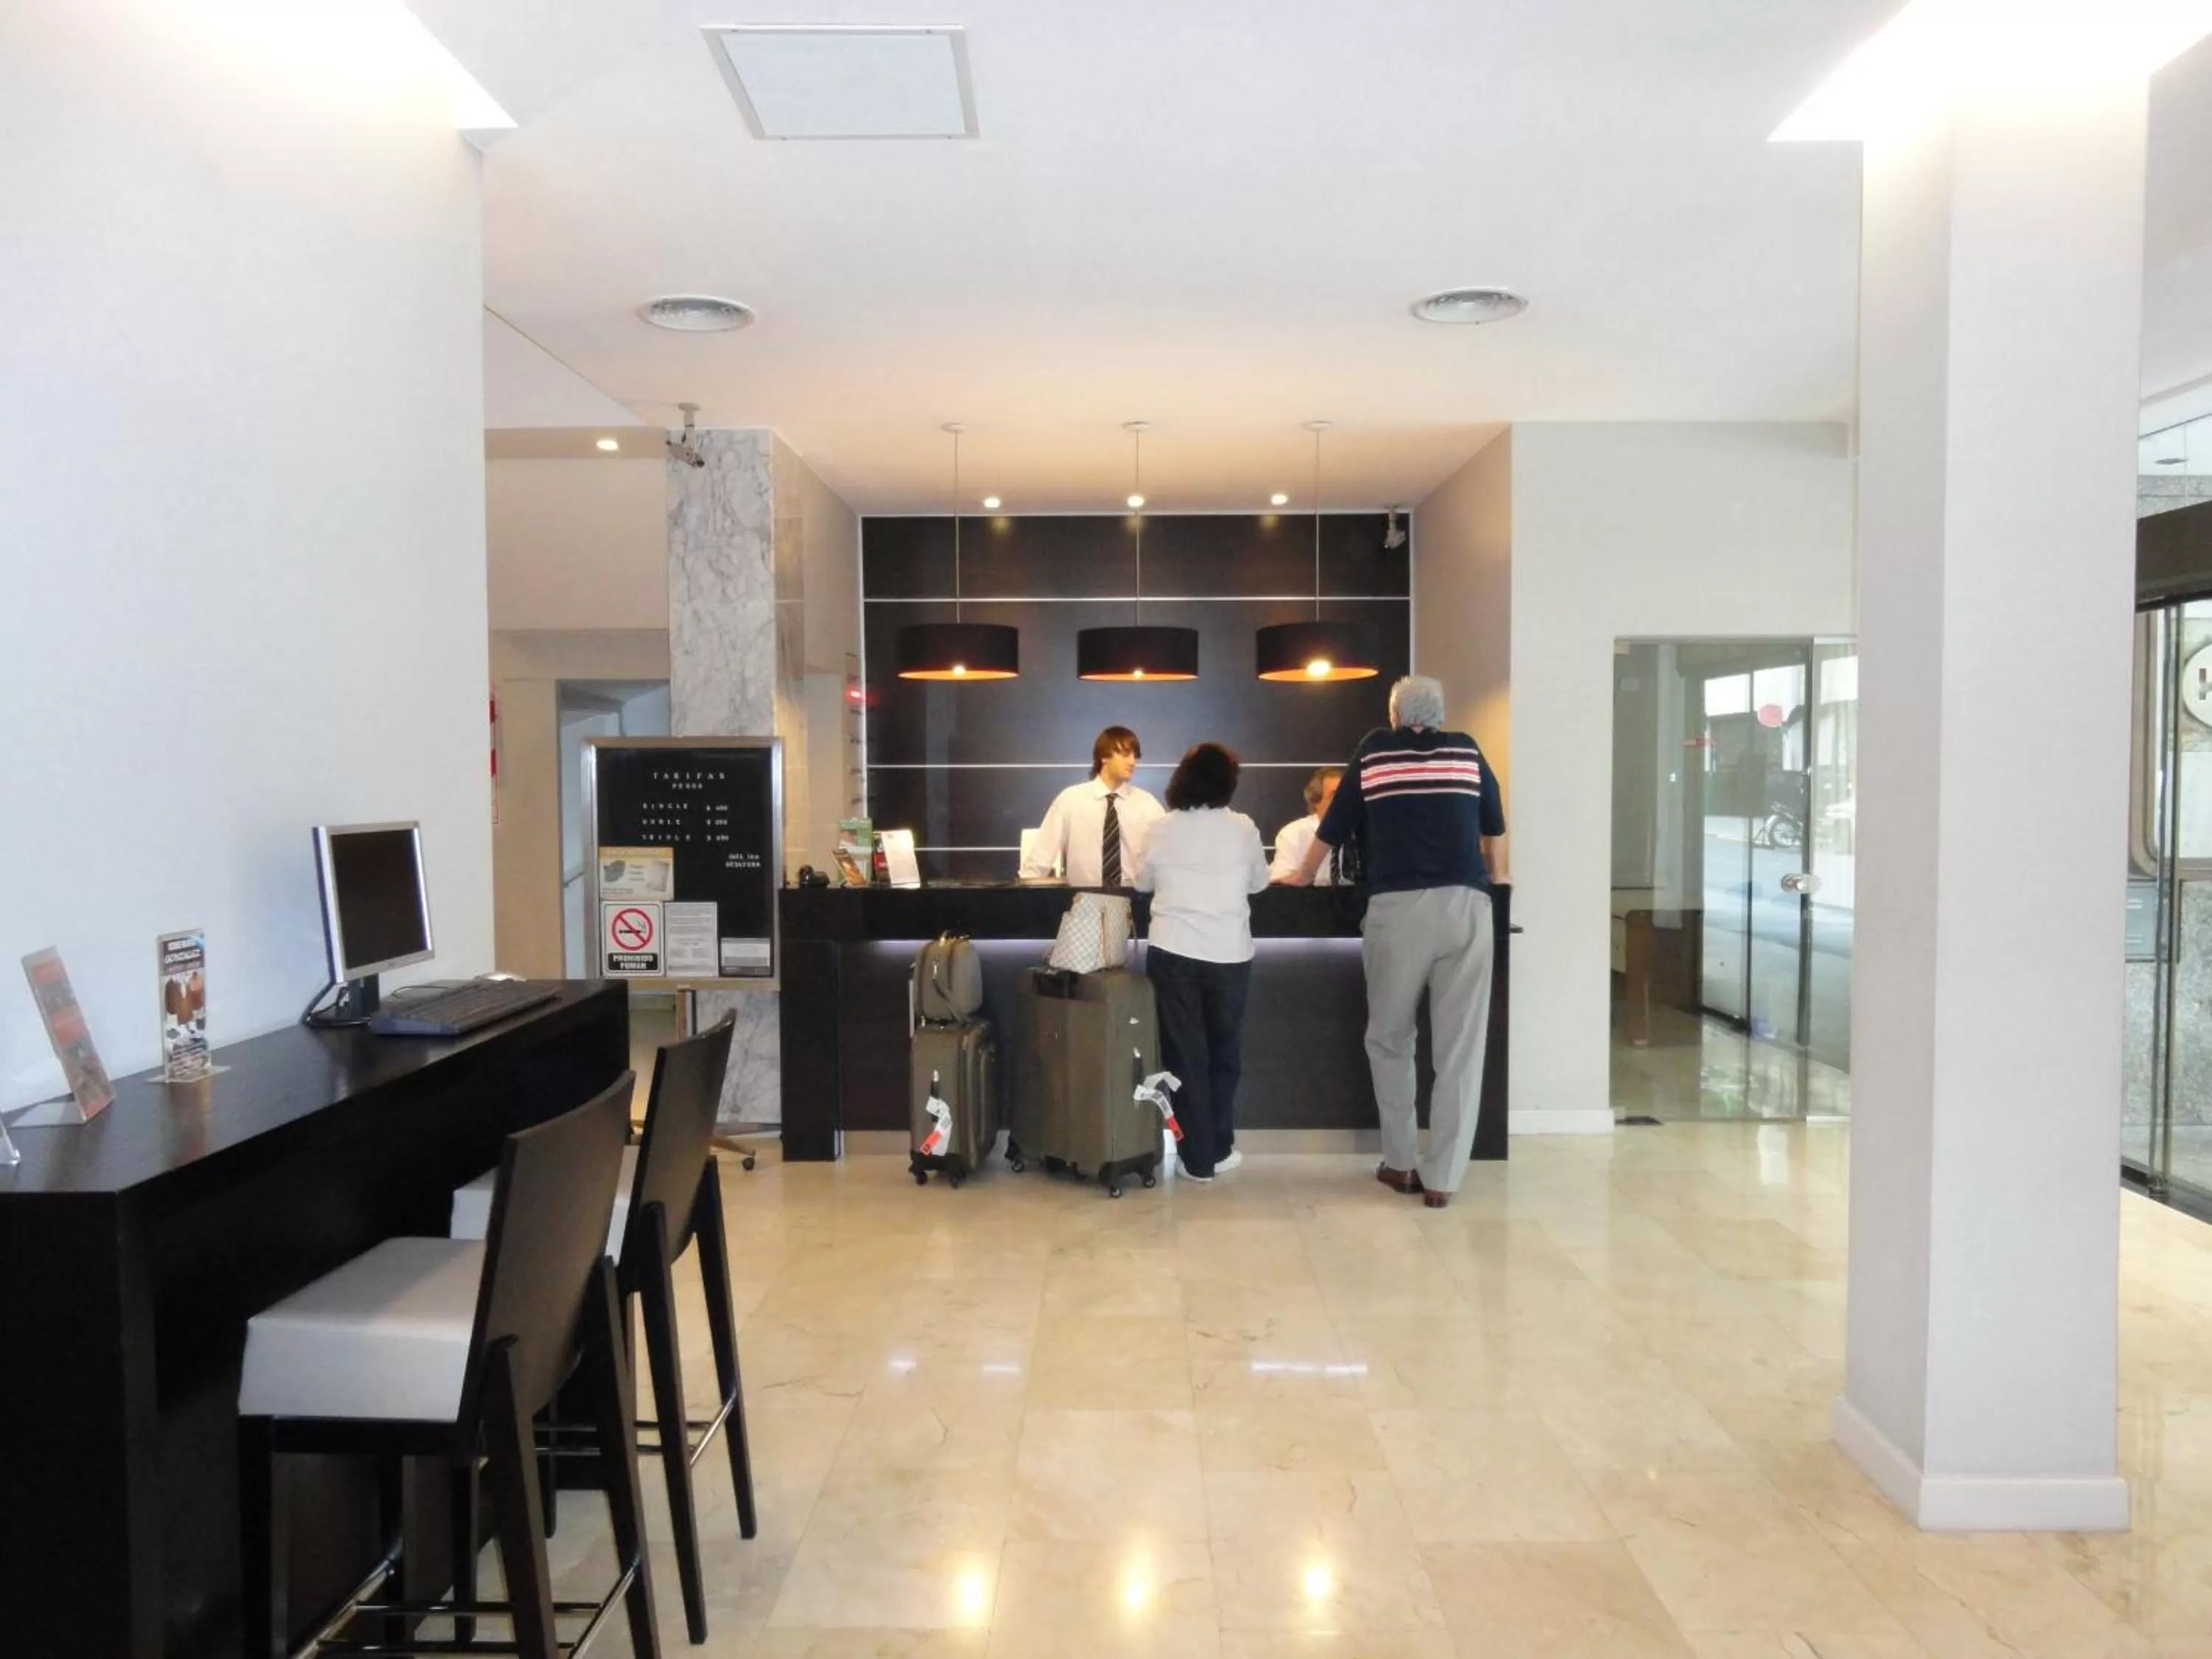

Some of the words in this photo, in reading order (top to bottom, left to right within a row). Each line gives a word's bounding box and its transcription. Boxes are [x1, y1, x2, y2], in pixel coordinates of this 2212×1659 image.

[653, 771, 726, 779] TARIFAS
[642, 802, 689, 810] SINGLE
[613, 954, 654, 962] PROHIBIDO
